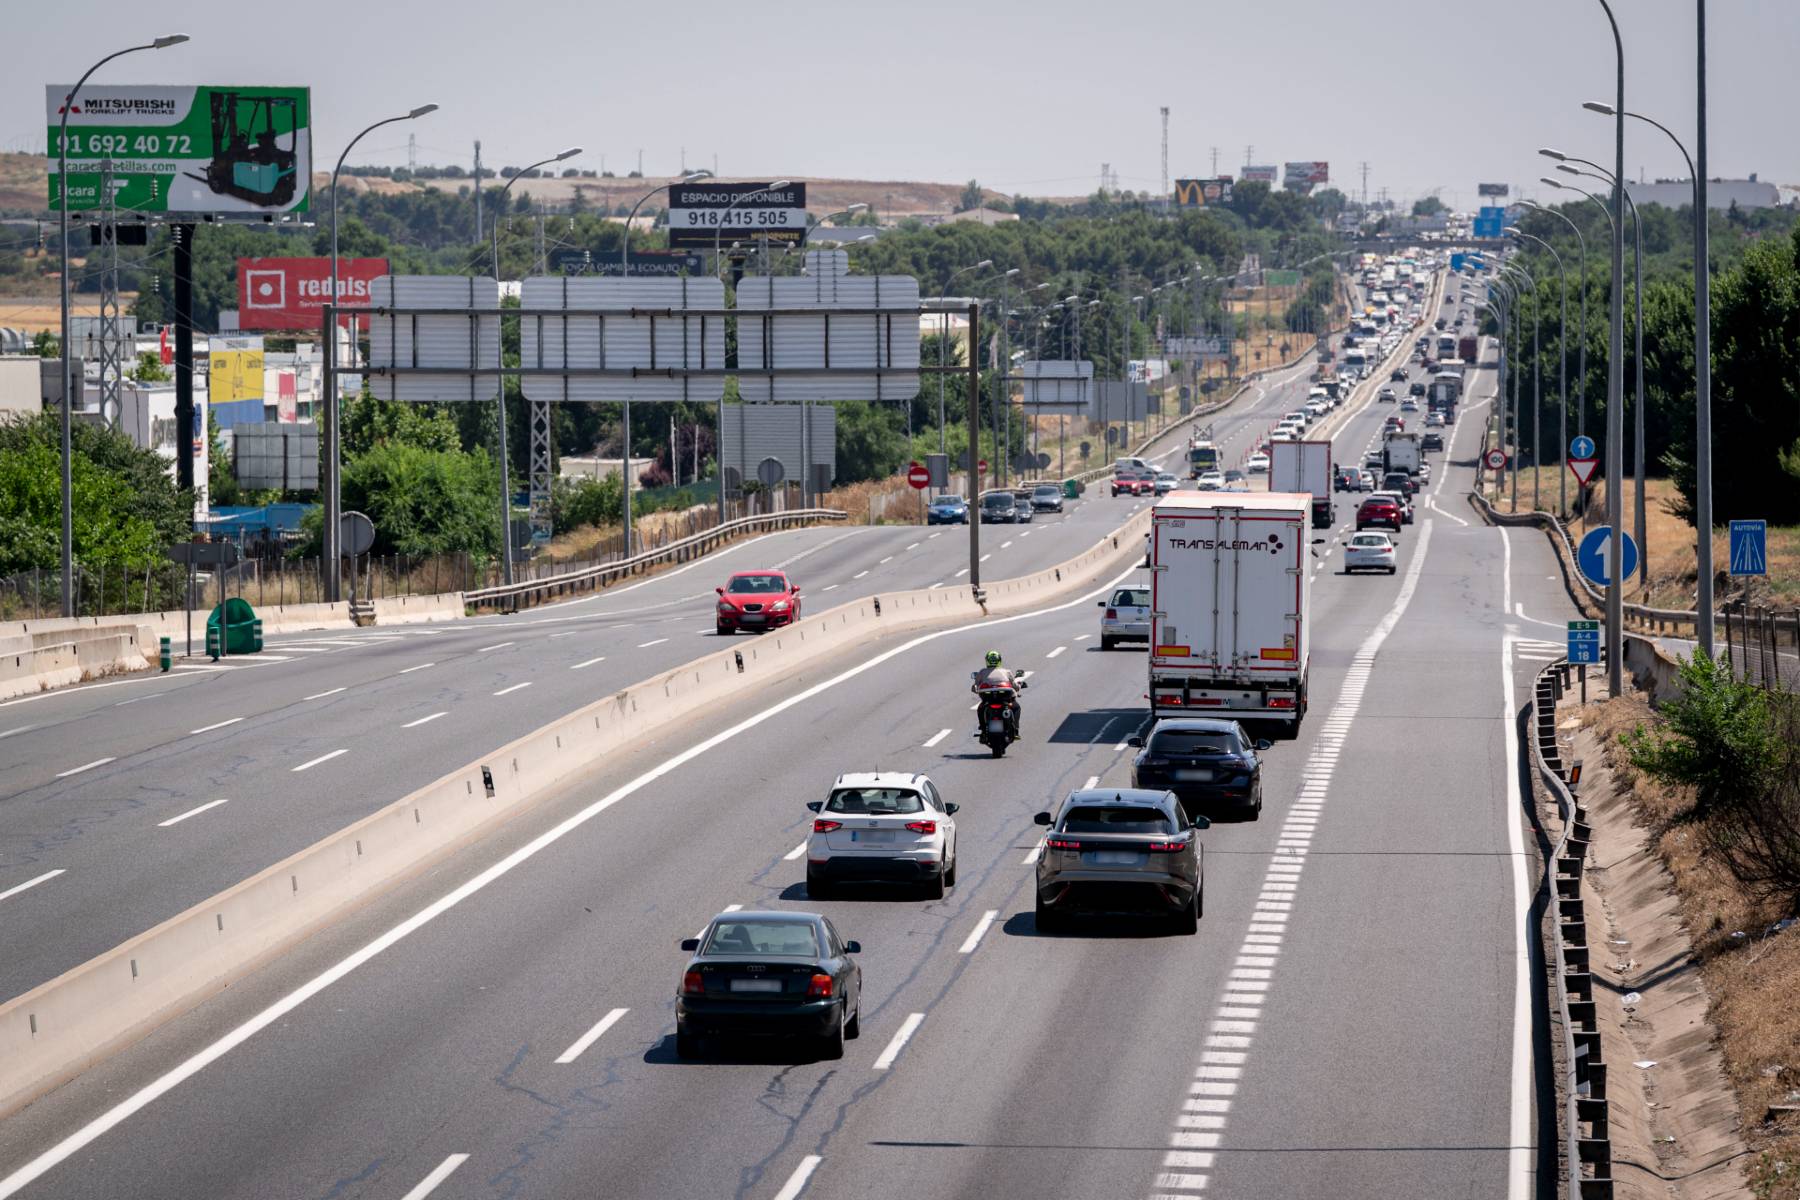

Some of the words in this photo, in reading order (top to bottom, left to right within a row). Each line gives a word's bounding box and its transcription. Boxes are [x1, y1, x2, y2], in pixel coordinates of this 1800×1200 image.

[84, 99, 175, 109] MITSUBISHI
[56, 135, 82, 153] 91
[88, 135, 128, 153] 692
[134, 135, 159, 153] 40
[166, 135, 192, 154] 72
[681, 192, 729, 203] ESPACIO
[730, 192, 795, 203] DISPONIBLE
[688, 211, 718, 225] 918
[721, 211, 753, 225] 415
[757, 211, 788, 225] 505
[1576, 632, 1591, 640] A-4
[1577, 650, 1590, 661] 18
